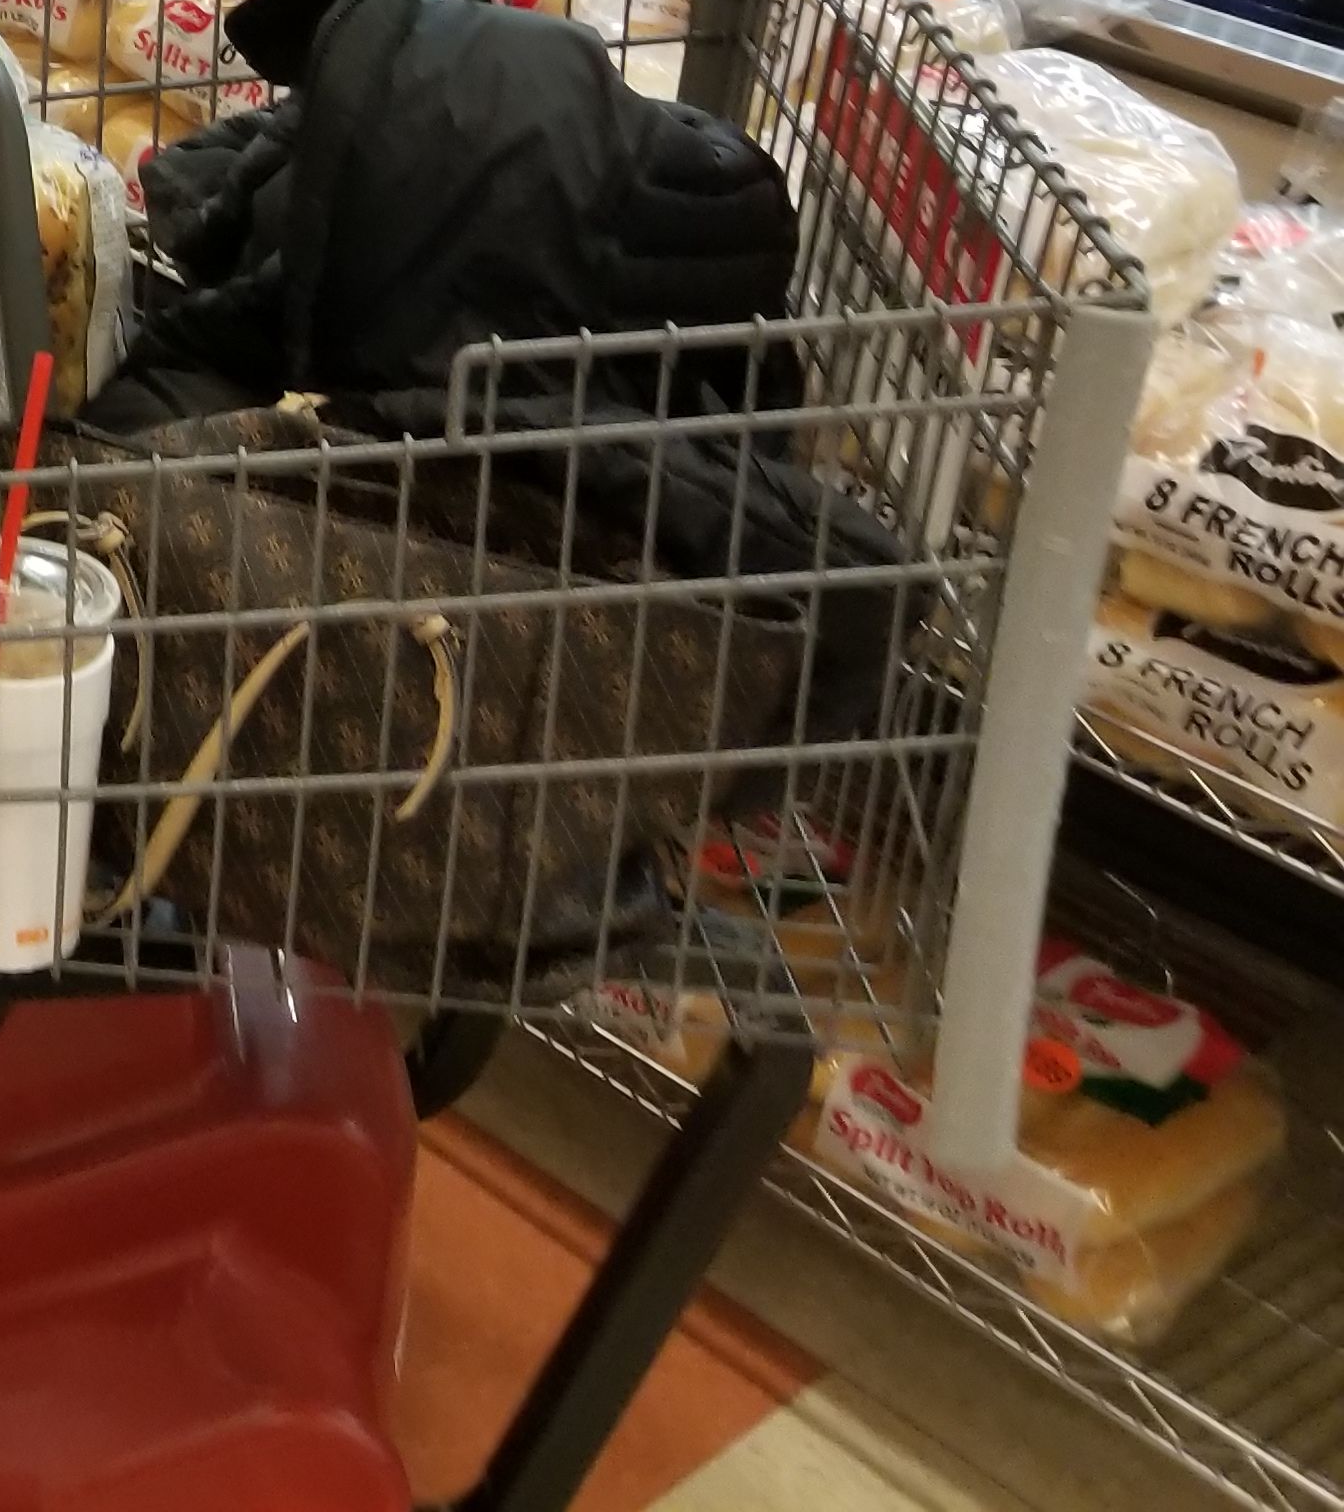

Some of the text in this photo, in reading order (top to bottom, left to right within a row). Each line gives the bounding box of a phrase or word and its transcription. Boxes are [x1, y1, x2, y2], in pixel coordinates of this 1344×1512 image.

[1145, 476, 1178, 515] 8
[1095, 640, 1315, 752] 8 FRENCH
[1183, 710, 1314, 793] ROLLS
[829, 1108, 913, 1175] Split
